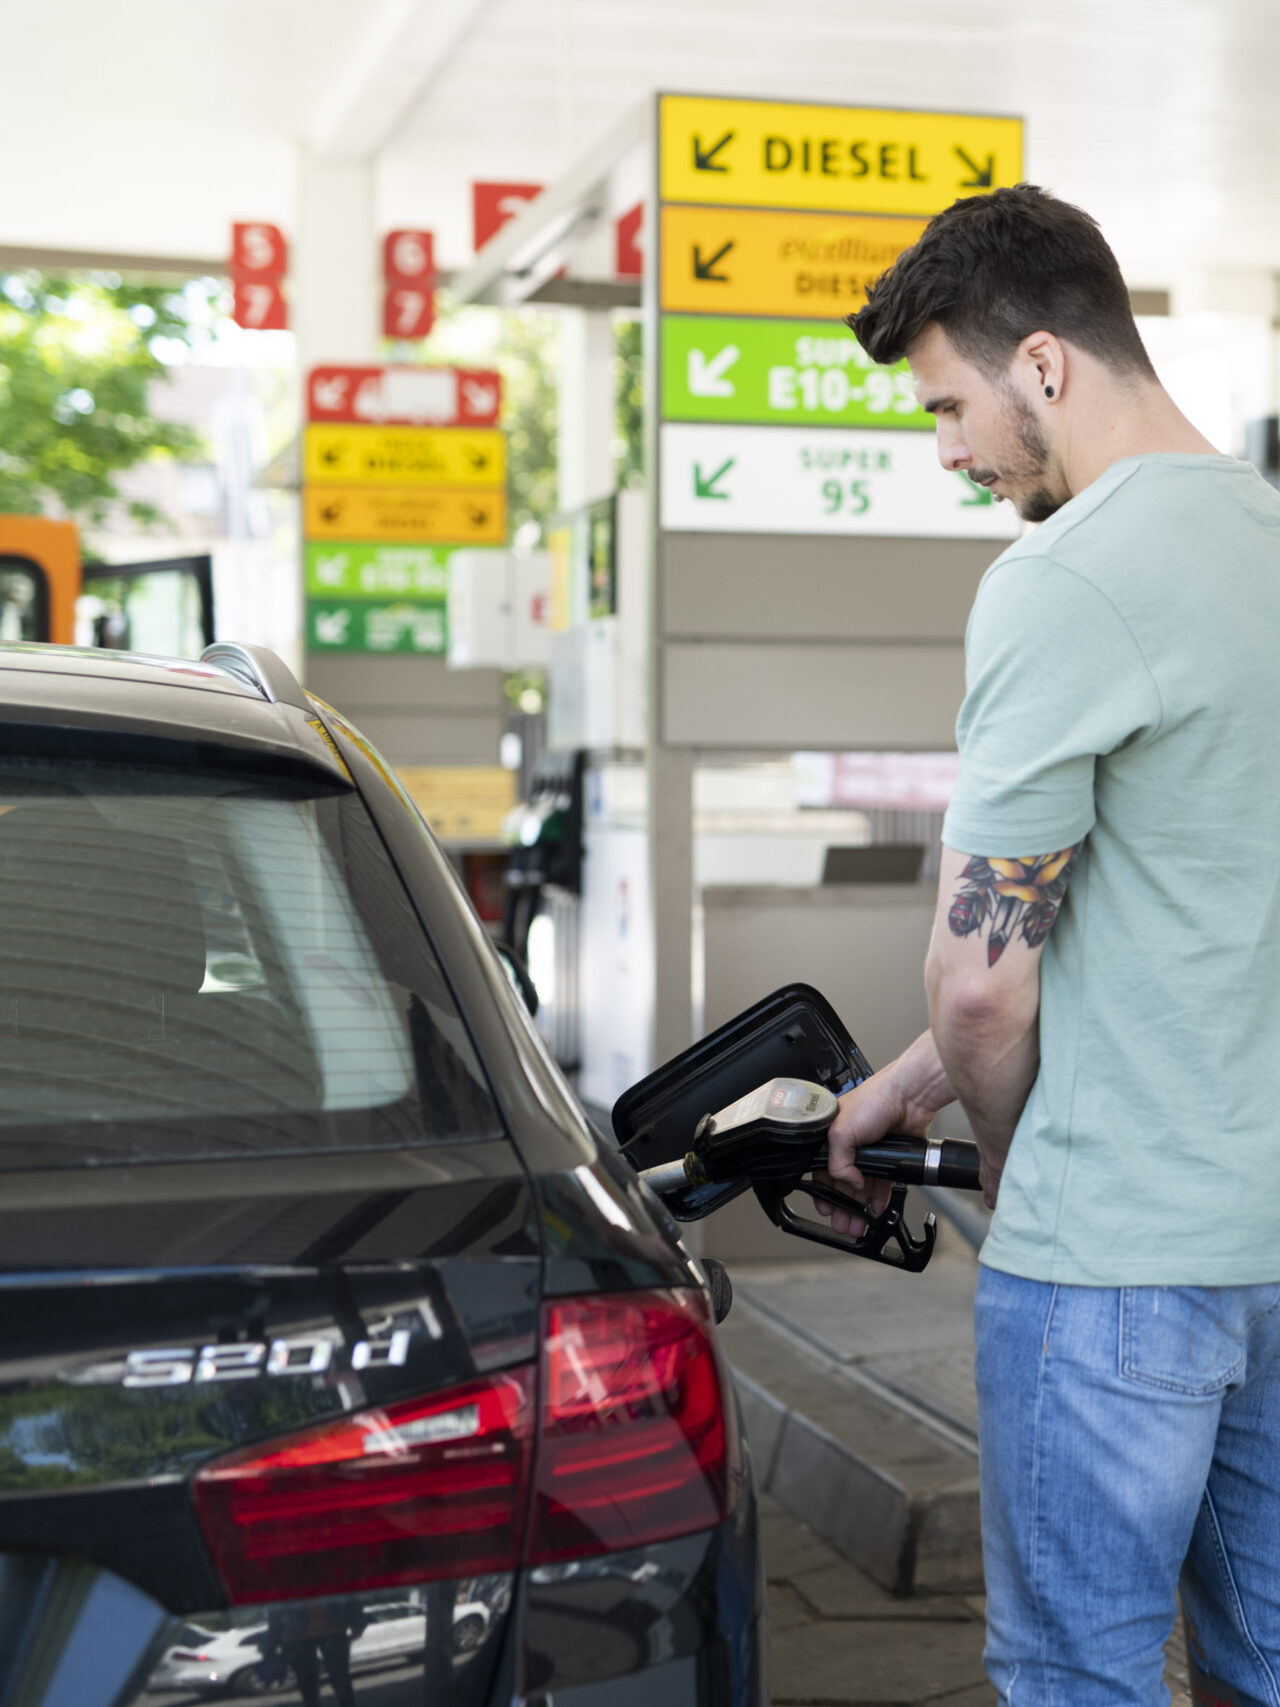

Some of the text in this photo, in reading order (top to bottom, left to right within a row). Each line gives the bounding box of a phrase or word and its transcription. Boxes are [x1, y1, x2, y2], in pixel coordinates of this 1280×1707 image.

[764, 136, 928, 183] DIESEL
[800, 446, 892, 470] SUPER
[821, 479, 871, 516] 95
